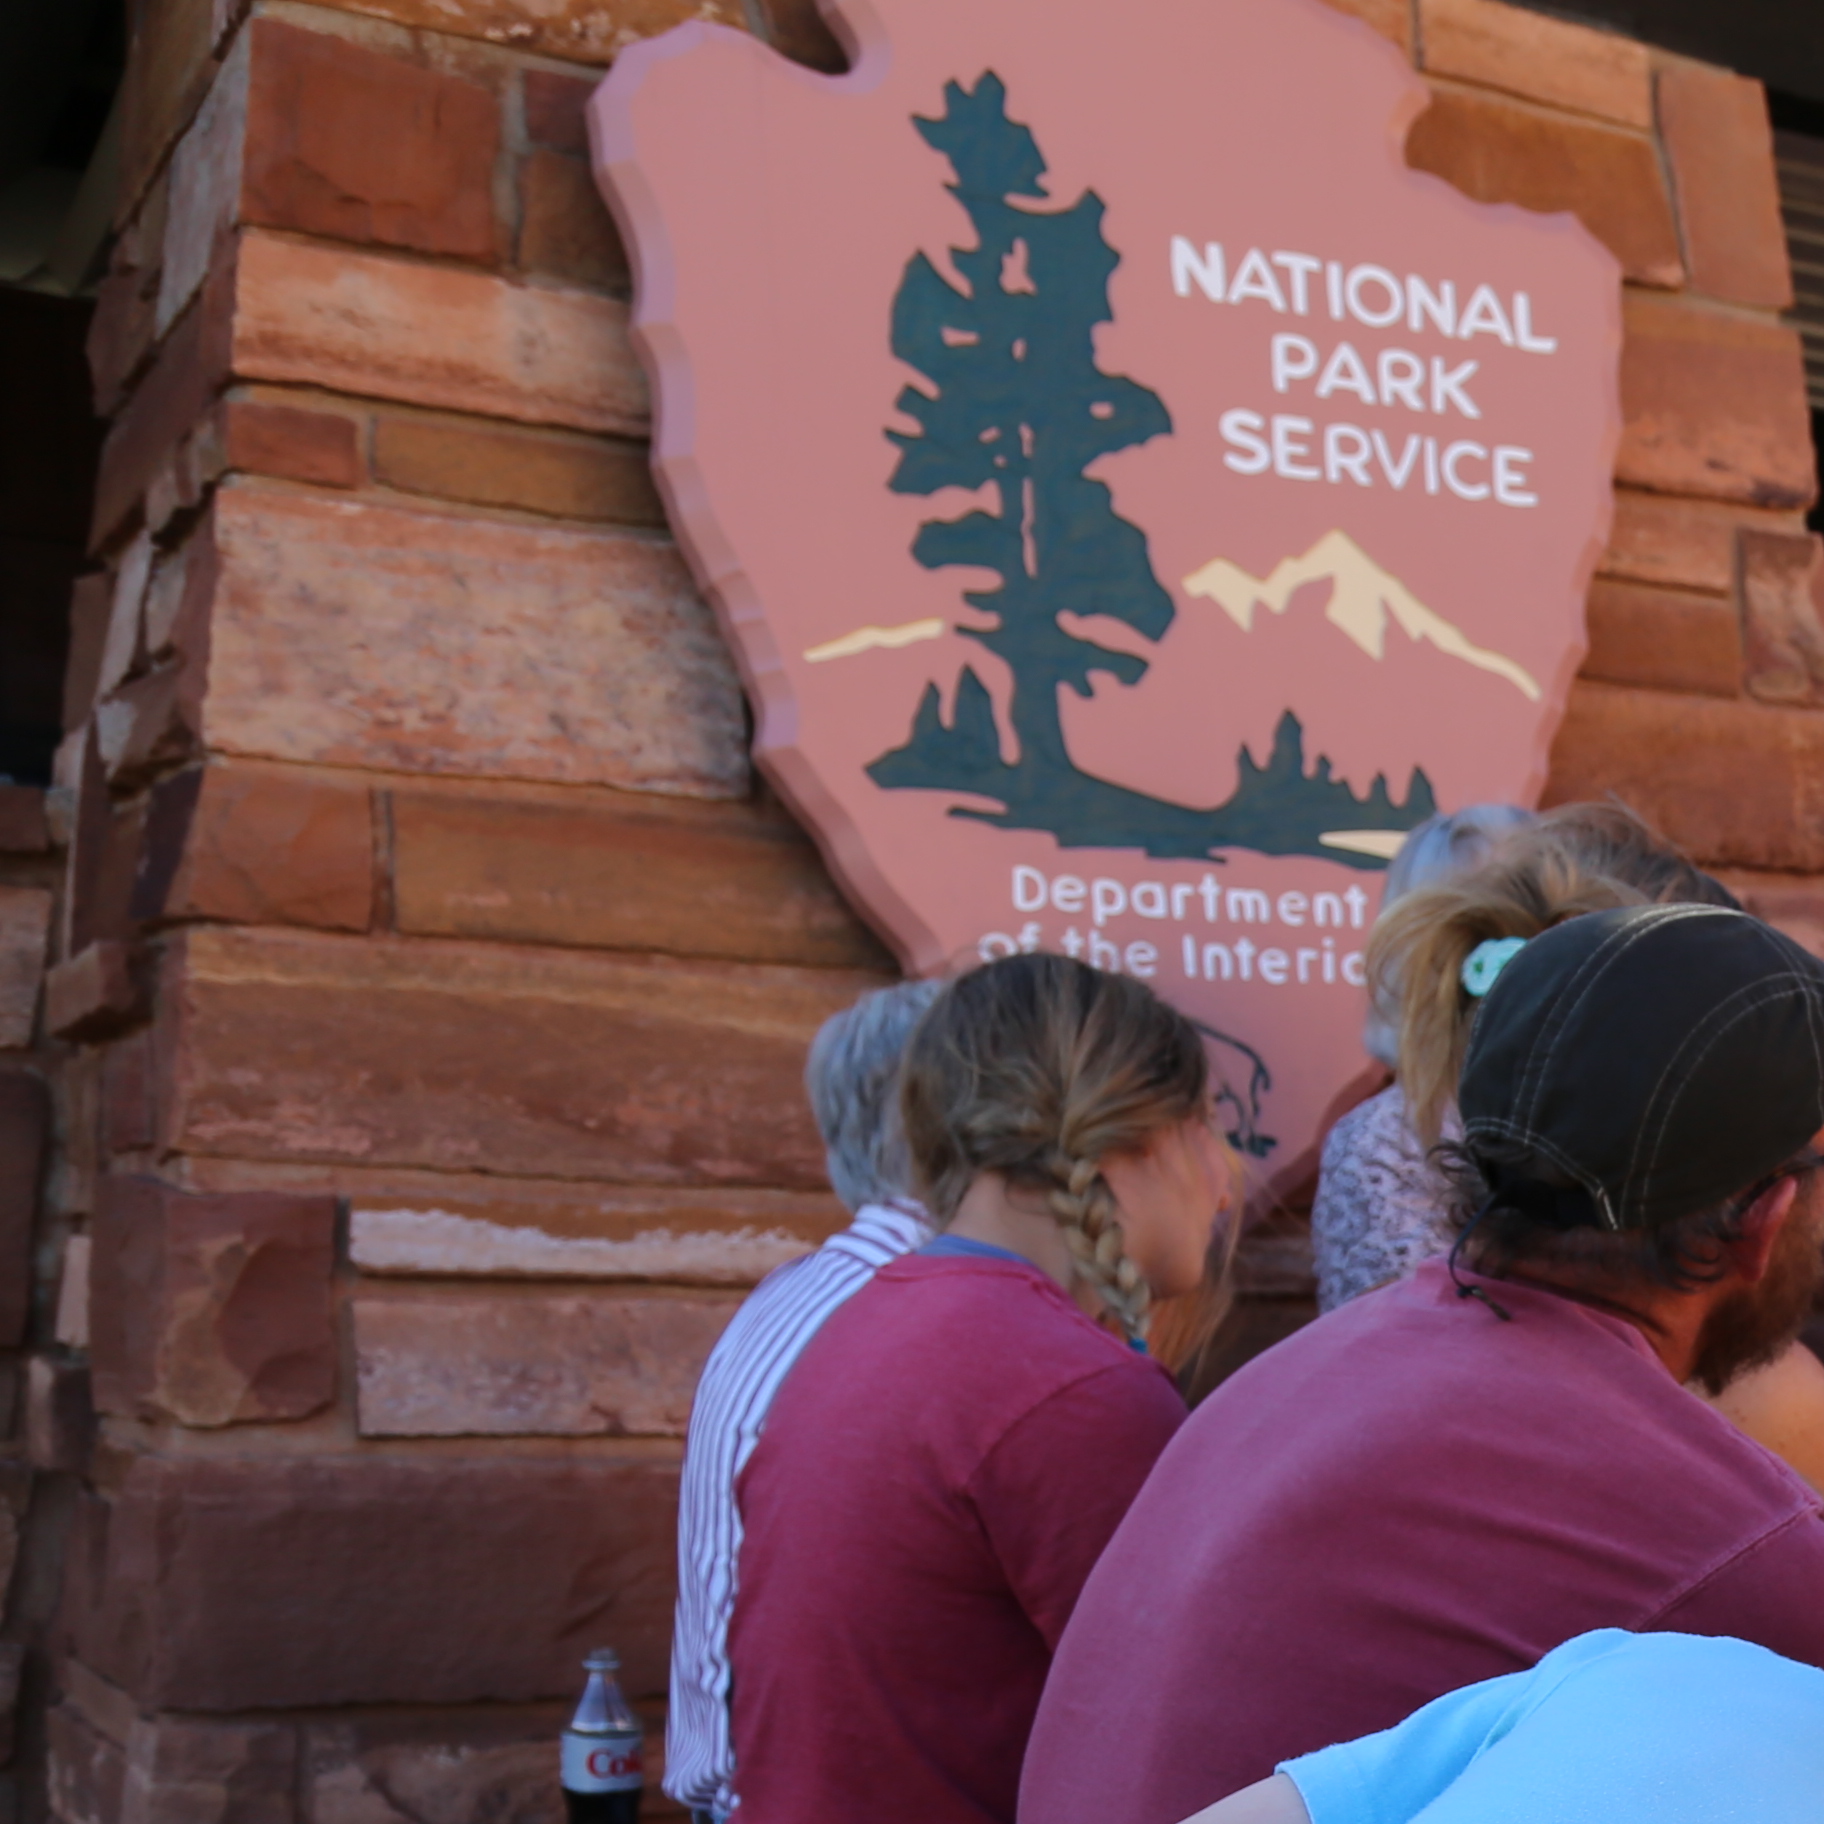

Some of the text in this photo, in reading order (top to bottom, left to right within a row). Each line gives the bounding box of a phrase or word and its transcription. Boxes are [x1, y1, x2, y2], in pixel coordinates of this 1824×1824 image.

[1169, 235, 1558, 355] NATIONAL
[1270, 339, 1482, 420] PARK
[1218, 410, 1540, 509] SERVICE
[1012, 865, 1367, 928] Department
[978, 922, 1368, 986] of the Interio
